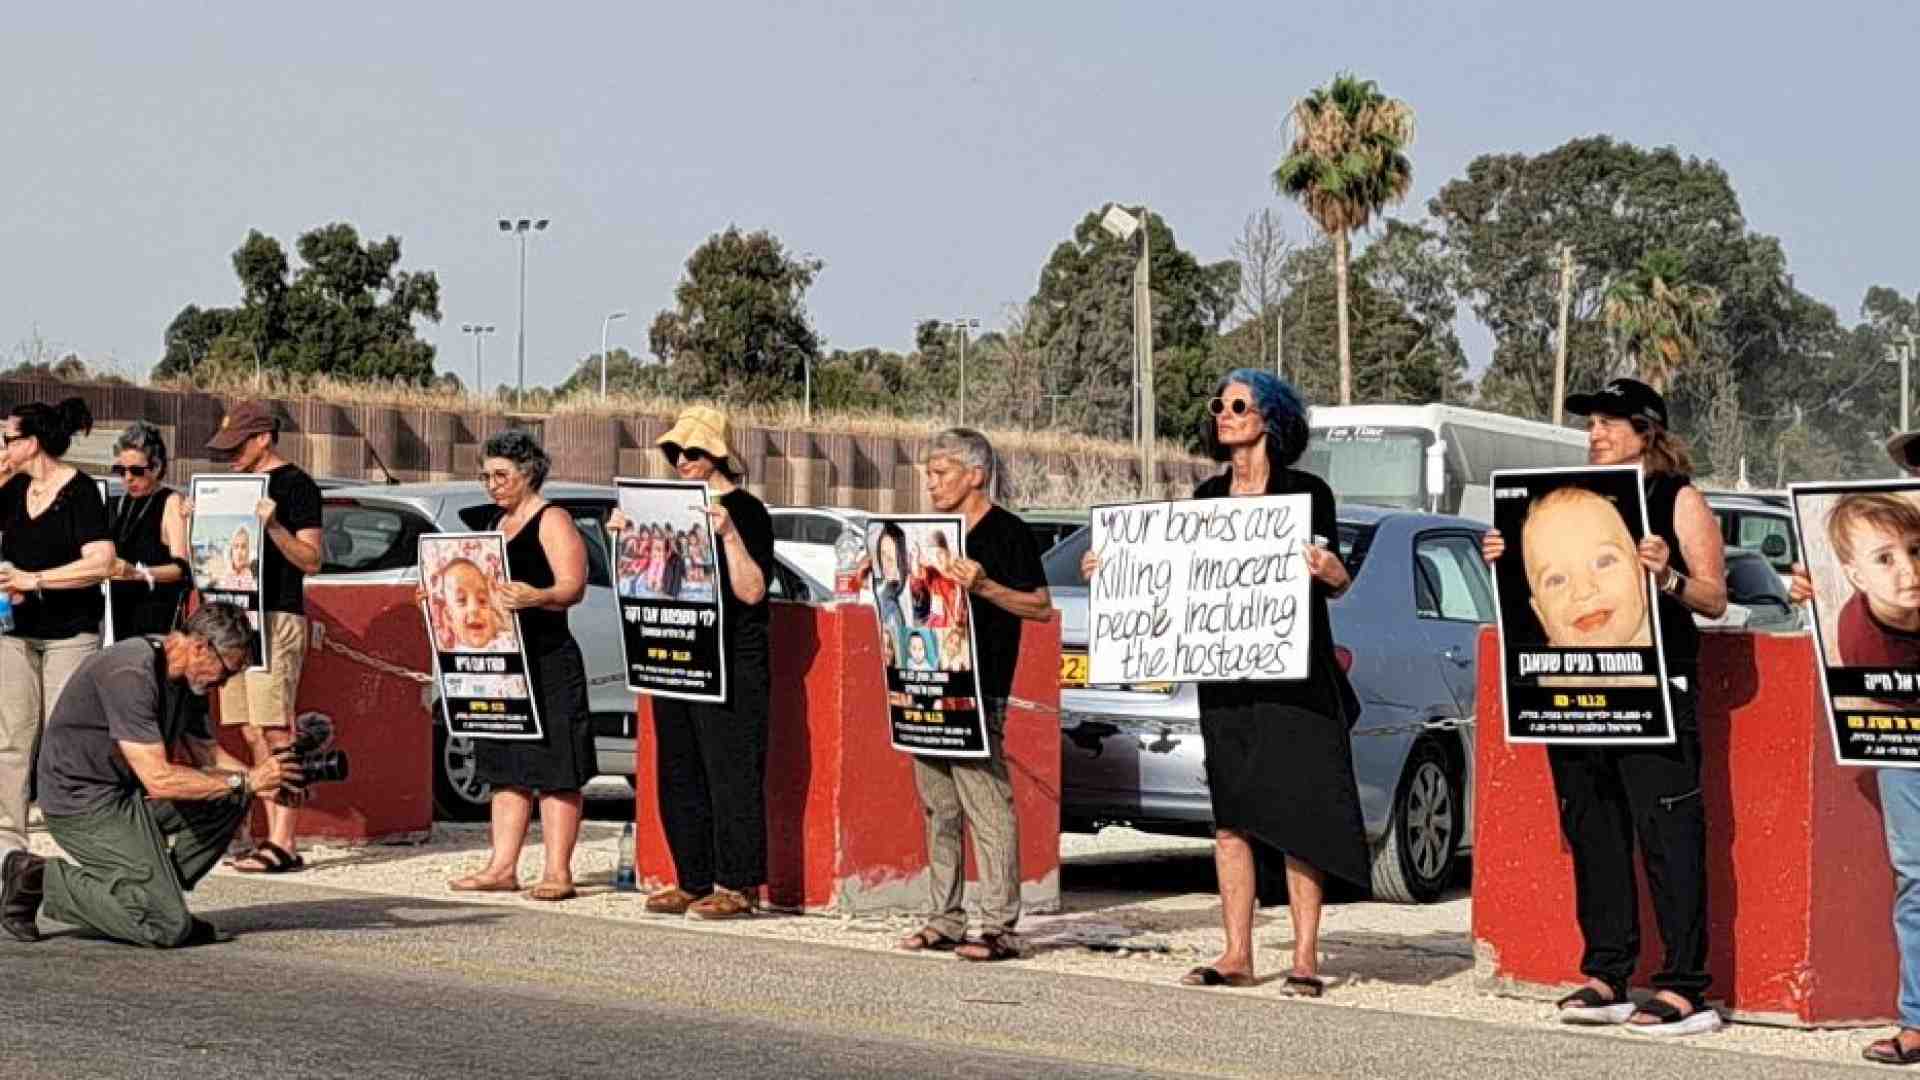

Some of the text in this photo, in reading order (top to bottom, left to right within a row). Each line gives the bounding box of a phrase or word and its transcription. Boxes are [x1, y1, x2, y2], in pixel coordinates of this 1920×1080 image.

[1099, 501, 1295, 553] your bombs are
[1188, 538, 1298, 591] innocent
[1095, 590, 1297, 652] people including
[1121, 633, 1293, 679] the hostages
